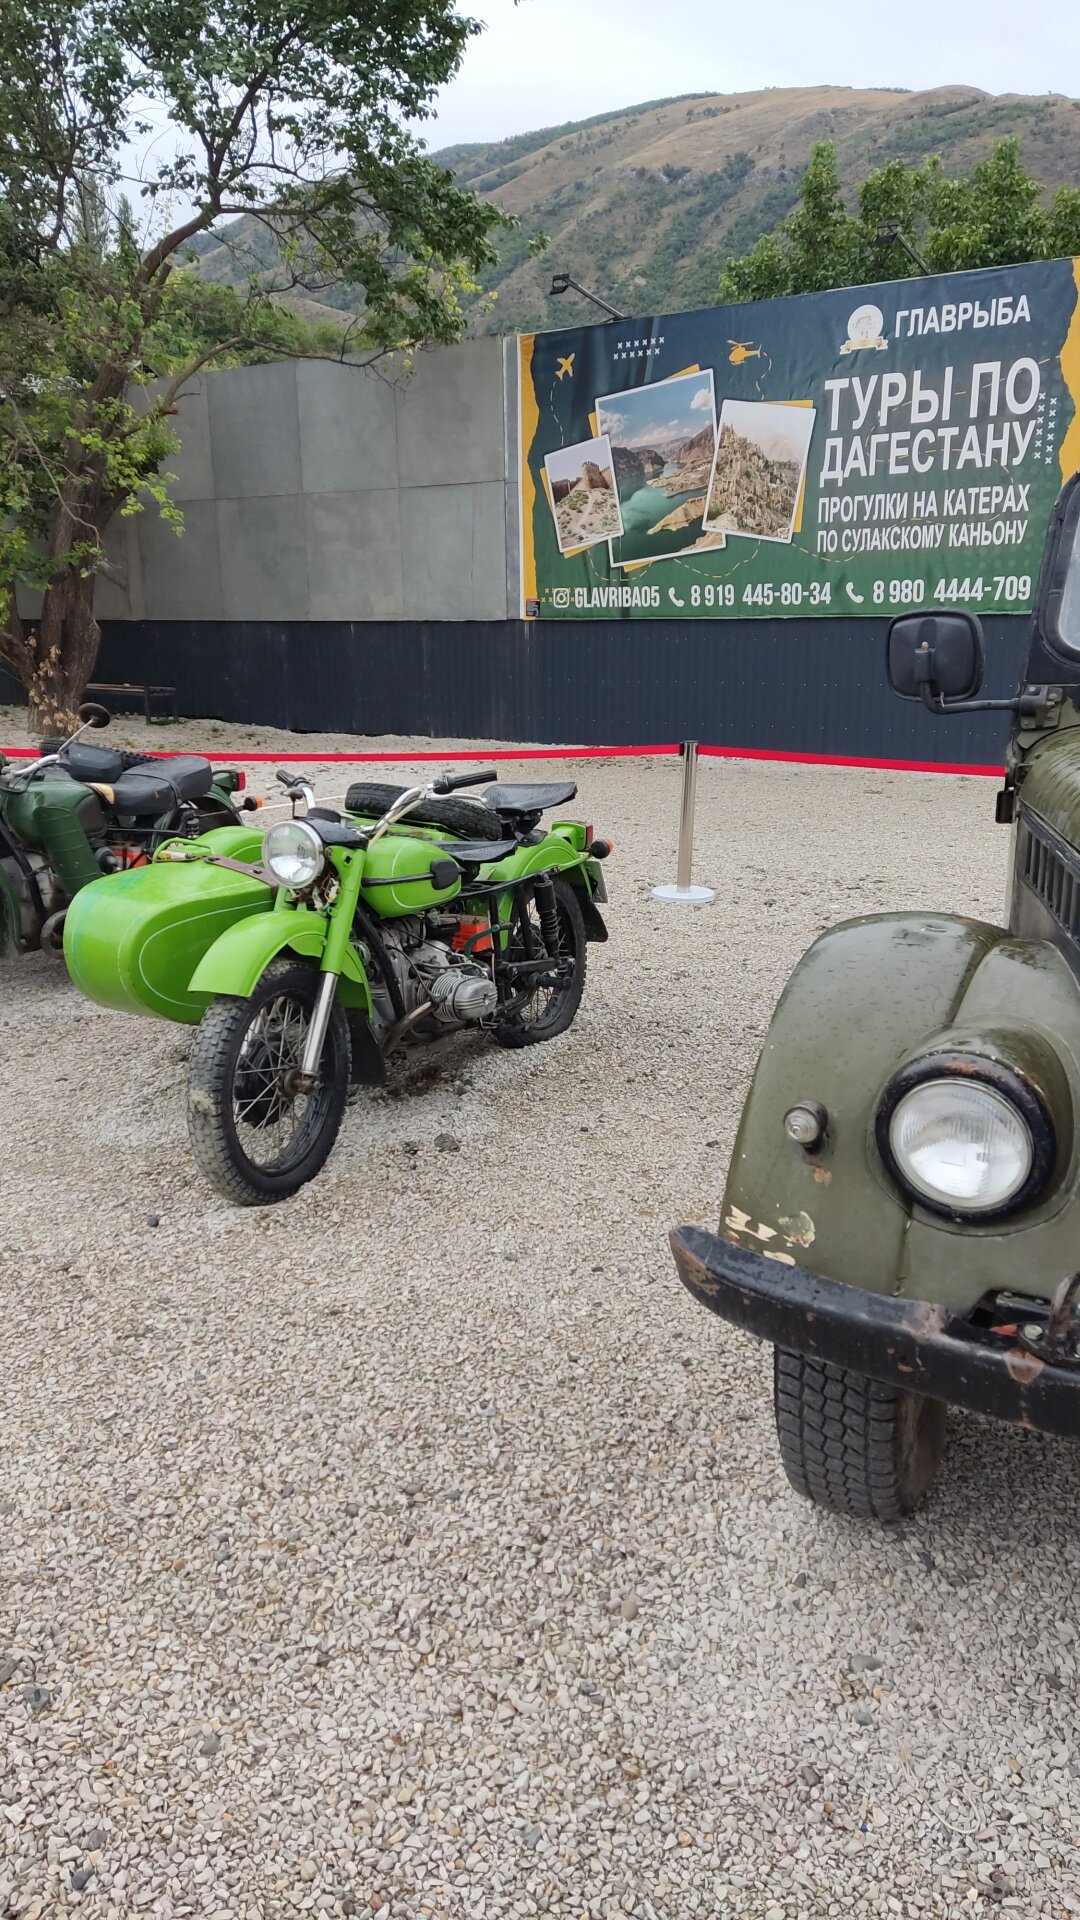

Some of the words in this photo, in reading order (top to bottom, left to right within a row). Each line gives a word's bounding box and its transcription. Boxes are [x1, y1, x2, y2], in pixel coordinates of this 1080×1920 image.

[895, 295, 1031, 338] ГЛАВРЫБА
[824, 366, 953, 431] ТУРЫ
[969, 357, 1040, 418] ПО
[819, 419, 1037, 488] ДАГЕСТАНУ
[818, 492, 909, 523] ПРОГУЛКИ
[913, 490, 938, 518] НА
[943, 483, 1031, 516] КАТЕРАХ
[817, 530, 838, 552] ПО
[841, 523, 945, 552] СУЛАКСКОМУ
[949, 519, 1028, 547] КАНЬОНУ
[574, 585, 660, 608] GLAVRIBA05
[690, 584, 701, 606] 8
[704, 584, 735, 606] 919
[742, 581, 831, 606] 445-80-34
[872, 580, 885, 603] 8
[889, 579, 925, 603] 980
[933, 575, 1032, 602] 4444-709
